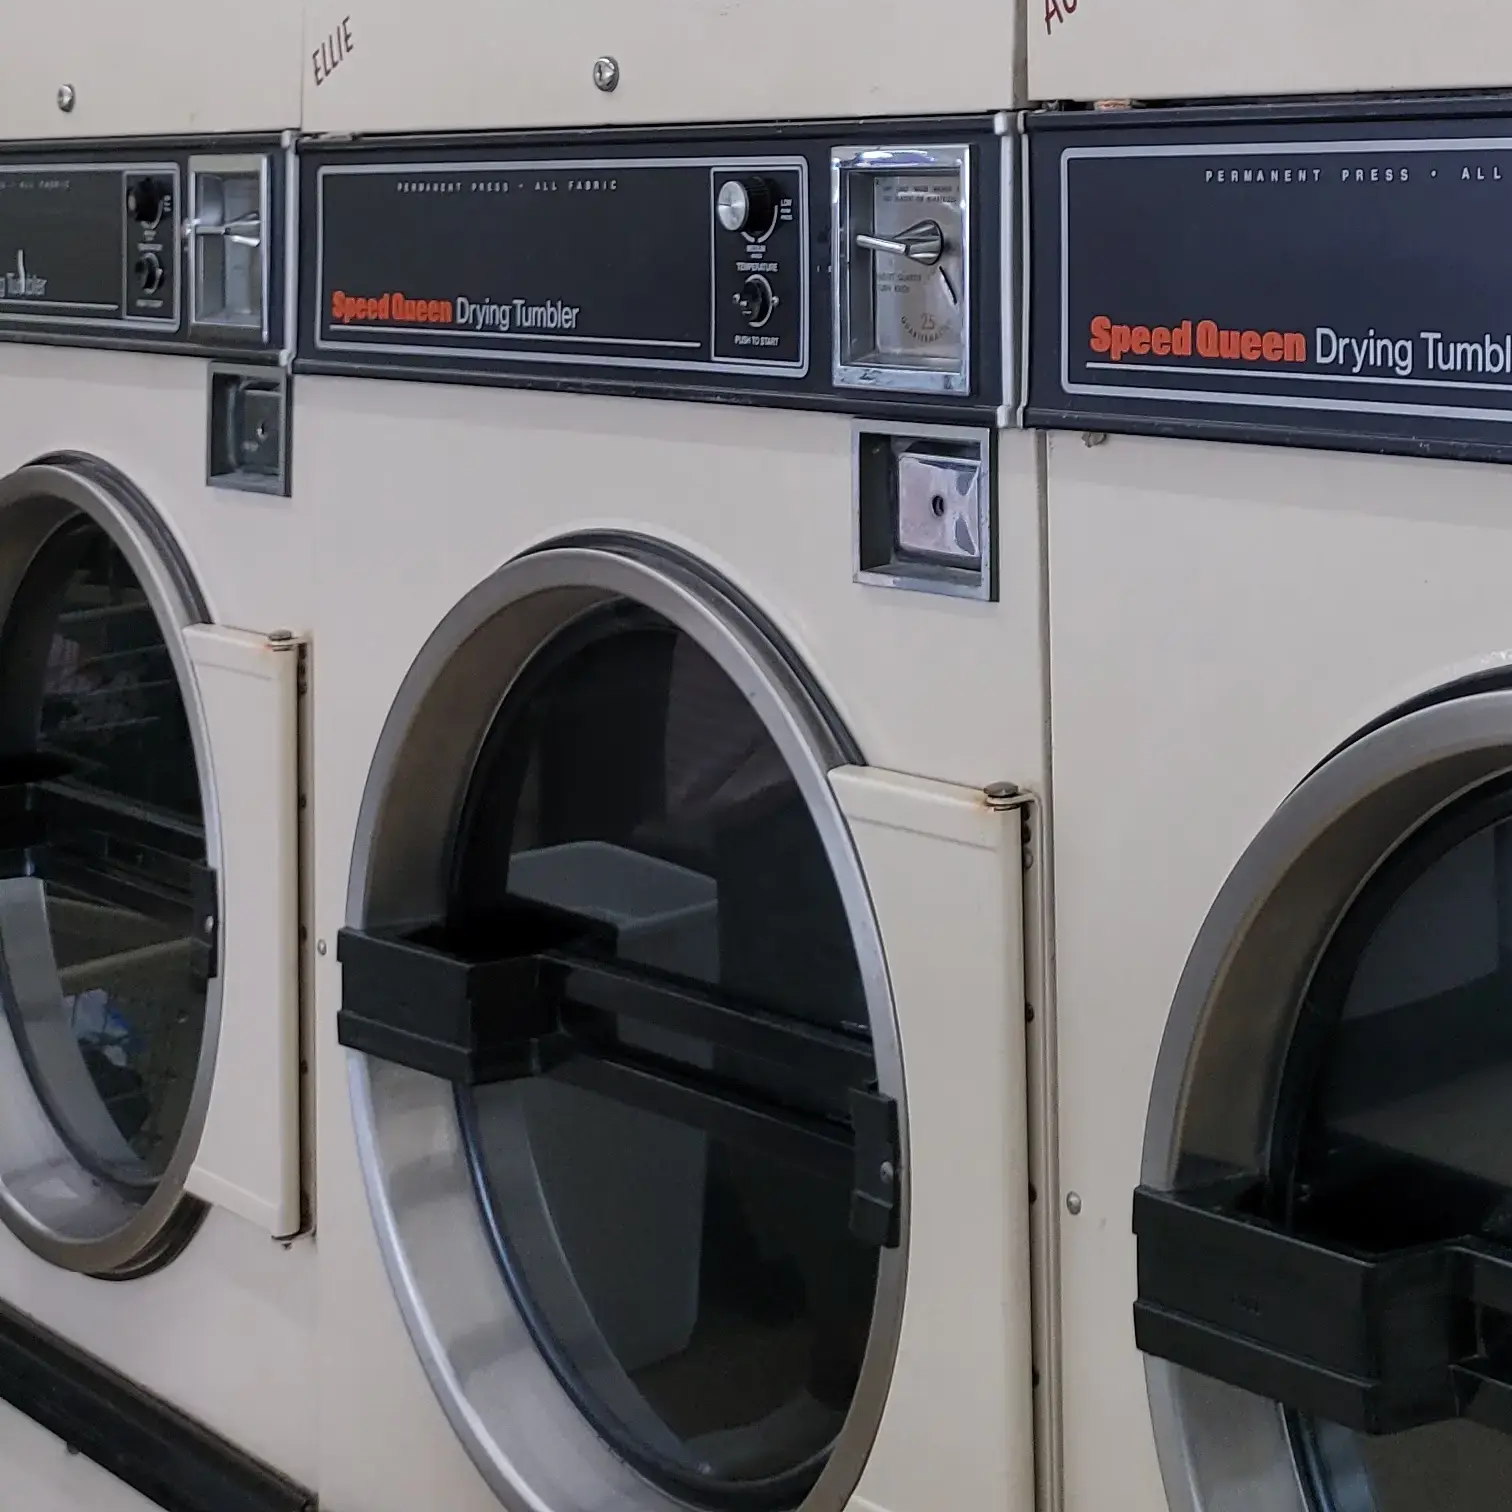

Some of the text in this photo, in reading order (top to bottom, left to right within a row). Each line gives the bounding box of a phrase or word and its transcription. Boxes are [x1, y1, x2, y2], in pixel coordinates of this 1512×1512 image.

[312, 15, 354, 87] ELLIE
[534, 181, 558, 191] ALL
[1205, 169, 1321, 183] PERMANENT
[1342, 168, 1410, 182] PRESS
[1461, 166, 1503, 180] ALL
[332, 290, 580, 331] Speed Queen Drying Tumbler
[1089, 315, 1191, 361] Speed
[1195, 319, 1307, 362] Queen
[1315, 327, 1415, 375] Drying
